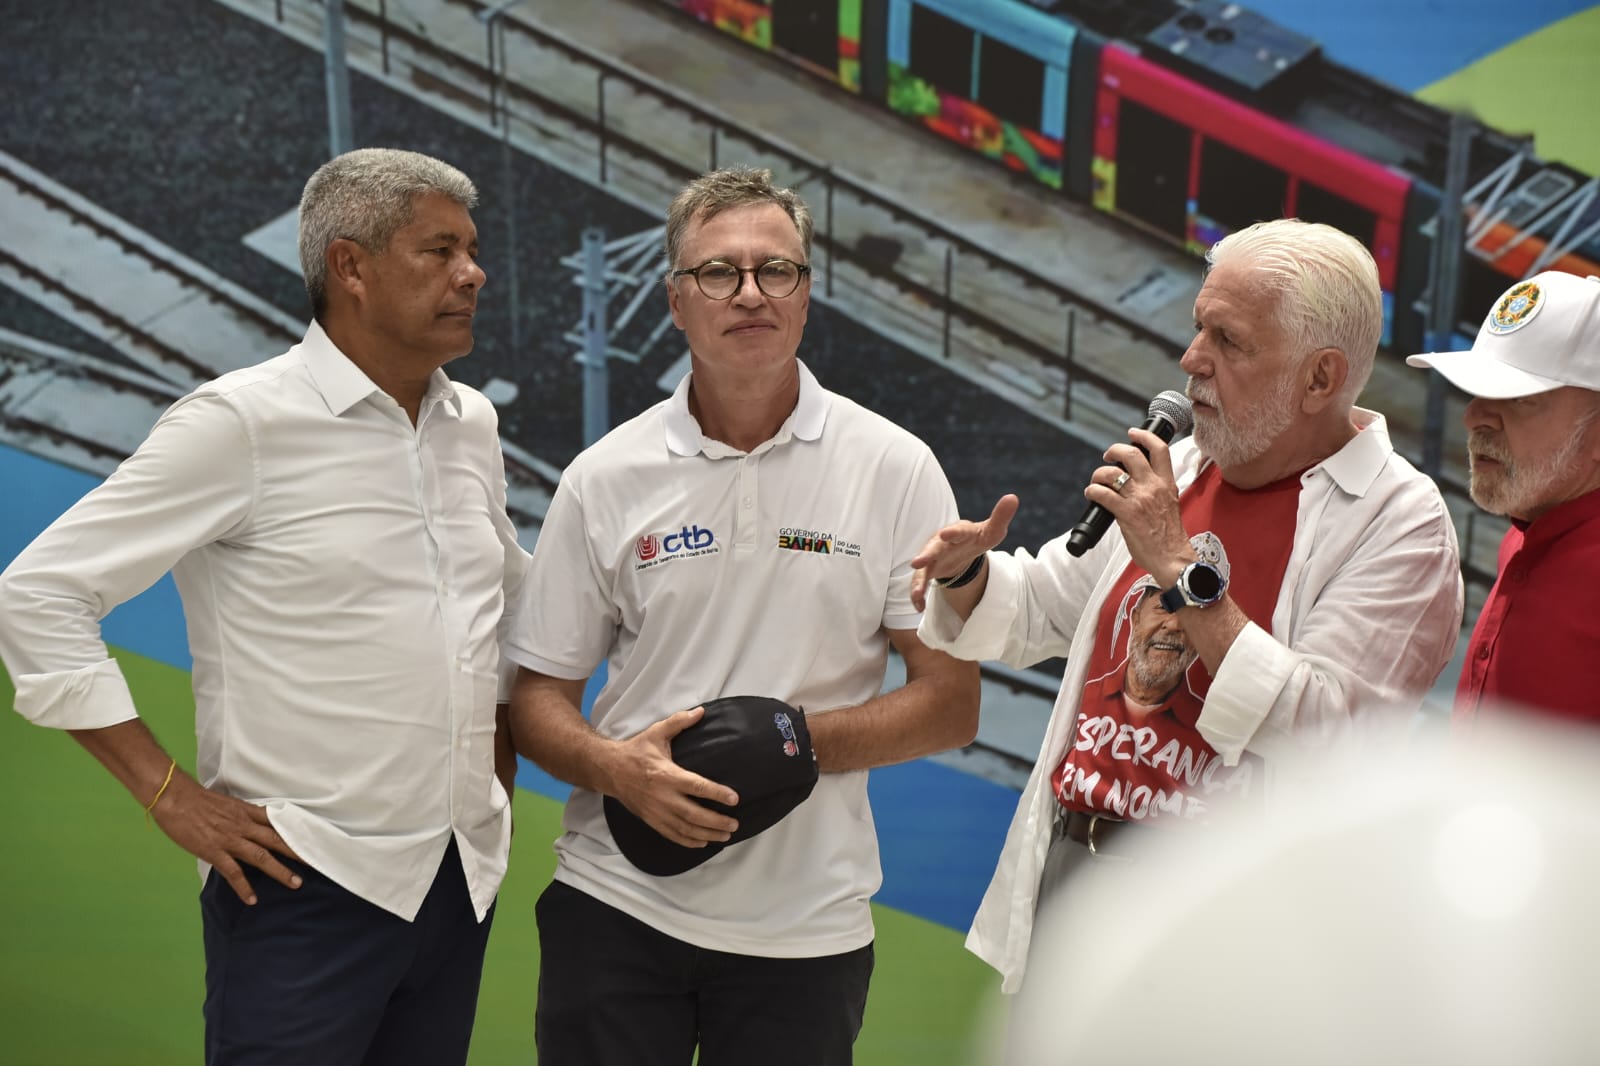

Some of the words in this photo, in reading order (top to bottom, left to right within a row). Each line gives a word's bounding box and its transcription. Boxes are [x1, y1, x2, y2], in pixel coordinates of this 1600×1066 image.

[663, 525, 714, 553] ctb
[779, 528, 820, 539] GOVERNO
[821, 533, 833, 541] DA
[779, 535, 832, 554] BAHIA
